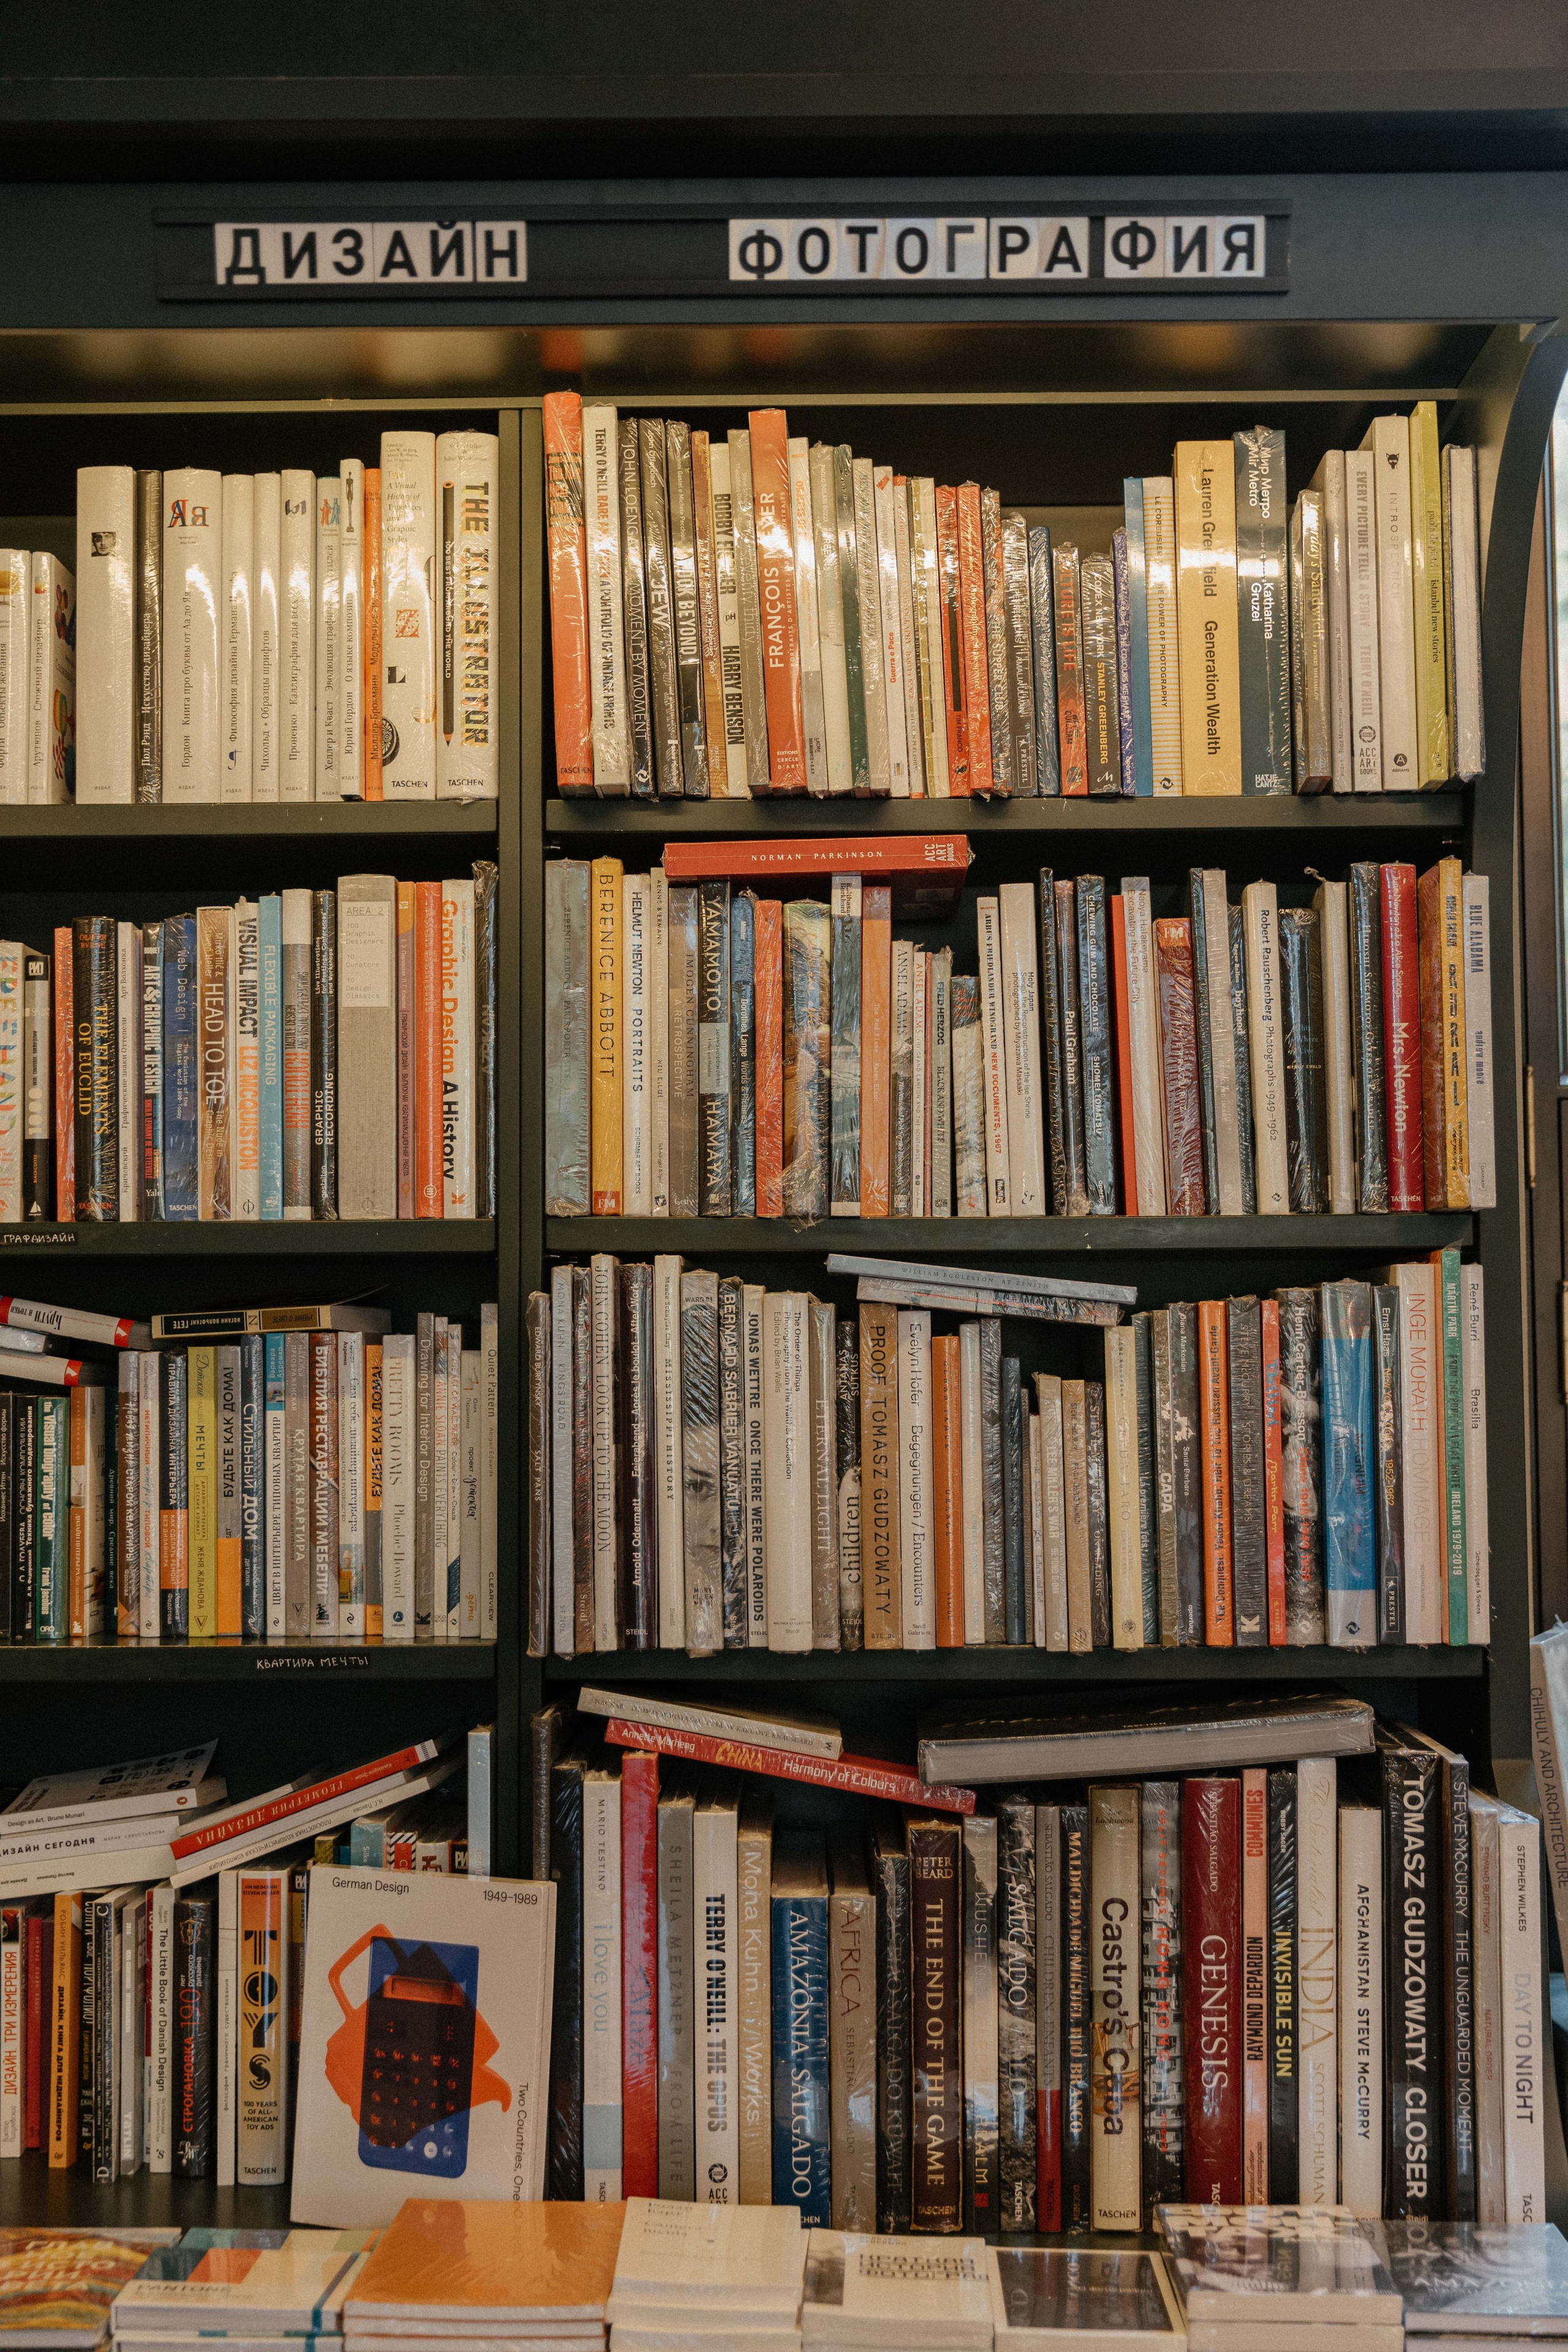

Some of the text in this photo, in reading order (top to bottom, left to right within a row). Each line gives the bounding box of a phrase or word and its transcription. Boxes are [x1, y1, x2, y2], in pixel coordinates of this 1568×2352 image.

[225, 221, 518, 284] ДИЗАЙН
[737, 219, 1257, 278] ФОТОГРАФИЯ
[141, 613, 152, 663] дизайнера
[462, 483, 489, 747] THE ILLUSTRATOR
[650, 579, 669, 626] JEW
[714, 494, 744, 744] BOBBY HARRY BENSON
[1202, 469, 1220, 755] Lauren Generation Wealth
[1251, 582, 1261, 621] Gruzei
[1264, 582, 1275, 639] Katharina
[1431, 578, 1439, 612] istanbul
[141, 666, 151, 713] Искусство
[182, 645, 192, 767] Гордон Книга буквы
[261, 631, 273, 719] Образцы шрифтов
[629, 584, 646, 739] MOMENT MOMENT
[141, 723, 151, 745] Рэнд
[1097, 662, 1108, 763] STANLEY GREENBERG
[1260, 910, 1271, 943] Robert
[1469, 905, 1483, 973] BLUE ALABAMA
[263, 945, 276, 1085] FLEXIBLE PACKAGING
[600, 874, 614, 1077] BERENICE ABBOTT
[631, 892, 643, 1092] HELMUT NEWTON PORTRAITS
[1262, 948, 1273, 1020] Rauschenberg
[78, 1023, 91, 1114] OF EUCLID
[94, 1003, 109, 1133] THE ELEMENTS
[205, 983, 224, 1104] HEAD TO TOE
[239, 918, 258, 1170] VISUAL IMPACT LIZ MCQUISTON
[443, 998, 460, 1074] Design
[706, 898, 721, 1186] YAMAMOTO HAMAYA
[1065, 1011, 1077, 1084] Paul Graham
[1265, 1027, 1276, 1087] Photographs
[1392, 1022, 1411, 1131] Mrs. Newton
[443, 1080, 458, 1095] A
[443, 1101, 460, 1179] History
[1447, 1283, 1456, 1313] MARTIN
[1447, 1316, 1457, 1337] PARR
[487, 1349, 496, 1378] Quiet
[488, 1382, 496, 1417] Pattern
[1409, 1293, 1427, 1430] INGE MORATH
[195, 1425, 206, 1471] МЕЧТЫ
[418, 1340, 430, 1501] Drawing for Interior Design
[595, 1266, 610, 1552] JOHN COHEN LOOK UP TO THE MOON
[243, 1404, 258, 1538] Стильный ДОМ
[294, 1429, 305, 1560] КРУТАЯ КВАРТИРА
[314, 1346, 328, 1594] БИБЛИЯ РЕСТАВРАЦИИ МЕБЕЛИ
[748, 1311, 764, 1621] JONAS WETTRE ONCE THERE WERE POLAROIDS
[870, 1325, 890, 1615] PROOF TOMASZ GUDZOWATY
[1161, 1472, 1172, 1512] CAPA
[1452, 1491, 1461, 1525] IRELAND
[197, 1569, 205, 1609] ЖДАНОВА
[257, 1656, 368, 1669] КВАРТИРА МЕЧТЫ
[45, 1838, 95, 1850] СЕГОДНЯ
[333, 1877, 374, 1891] German
[375, 1880, 410, 1894] Design
[705, 1894, 725, 1953] TERRY
[156, 1928, 168, 2092] The Little Book of Danish Design
[1201, 1935, 1227, 2089] GENESIS
[1246, 1936, 1263, 2060] RAYMOND DEPARDON
[1275, 1931, 1292, 2076] INVISIBLE SUN
[1300, 1926, 1333, 2051] INDIA
[1357, 1885, 1370, 2139] AFGHANISTAN STEVE McCURRY
[1403, 1775, 1427, 2198] TOMASZ GUDZOWATY CLOSER
[1515, 1845, 1533, 2124] STEPHEN WILKES NIGHT
[183, 2037, 193, 2132] СТРОГАНОВКА
[707, 2039, 727, 2075] THE
[790, 1910, 813, 2197] AMAZÔNIA SALGADO
[925, 1899, 944, 2185] THE END OF THE GAME
[707, 2081, 728, 2132] OPUS
